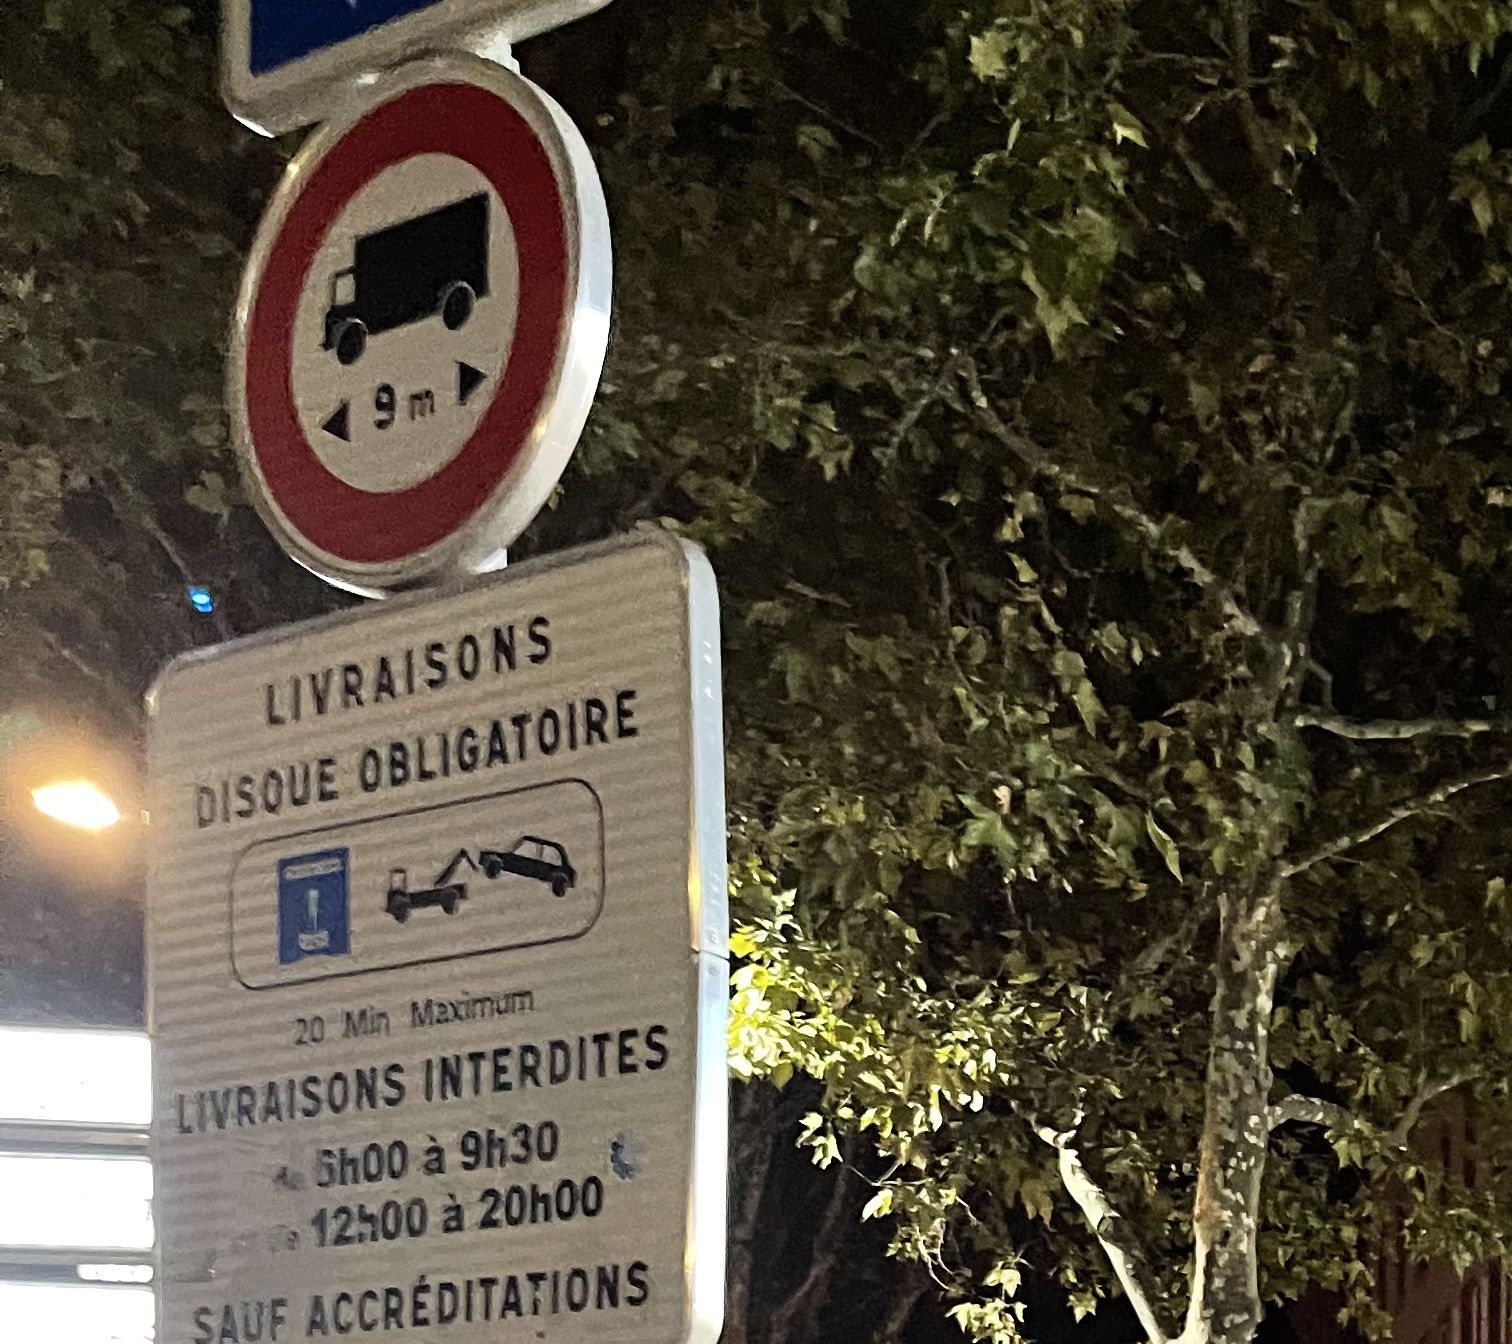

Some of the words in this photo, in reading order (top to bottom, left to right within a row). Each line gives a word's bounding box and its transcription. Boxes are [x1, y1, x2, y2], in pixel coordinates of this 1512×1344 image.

[374, 383, 396, 430] 9
[409, 389, 436, 421] m
[266, 616, 553, 726] LIVRAISONS
[192, 757, 339, 829] DISQUE
[359, 690, 639, 792] OBLIGATOIRE
[293, 1018, 325, 1046] 20
[343, 1010, 391, 1038] Min
[411, 989, 535, 1027] Maximum
[177, 1063, 405, 1135] LIVRAISONS
[425, 1025, 670, 1102] INTERDITES
[423, 1134, 446, 1175] à
[461, 1120, 559, 1170] 9h30
[311, 1197, 429, 1247] 12h00
[441, 1192, 466, 1234] à
[479, 1175, 605, 1230] 20h00
[306, 1261, 650, 1338] ACCRÉDITATIONS
